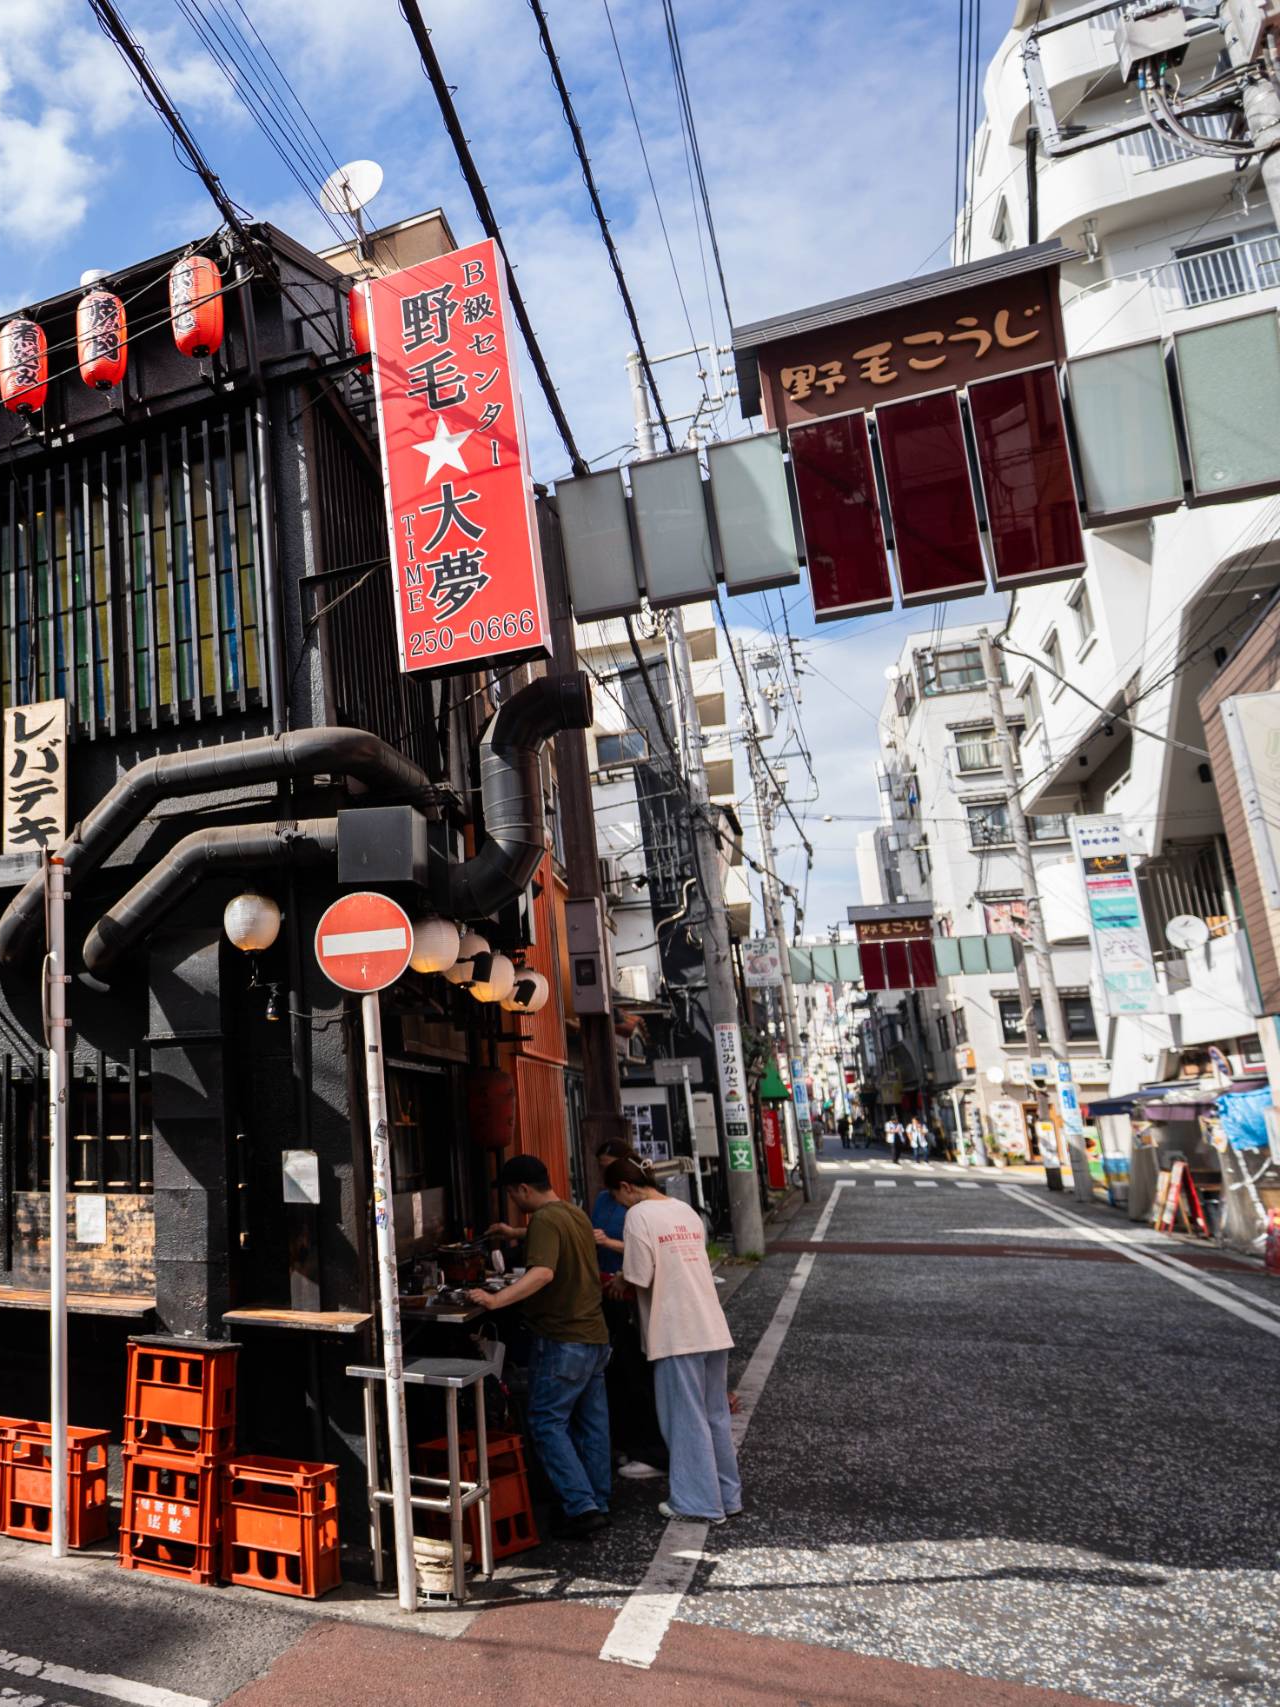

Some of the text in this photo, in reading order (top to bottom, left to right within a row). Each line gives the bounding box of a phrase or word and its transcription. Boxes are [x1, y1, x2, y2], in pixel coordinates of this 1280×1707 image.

[400, 281, 468, 412] 野毛
[460, 258, 501, 467] B級センター
[780, 304, 1041, 401] 野毛こうじ
[400, 512, 426, 614] TIME
[418, 481, 492, 625] 大夢
[408, 608, 536, 658] 250-0666
[8, 711, 63, 850] レバテキ
